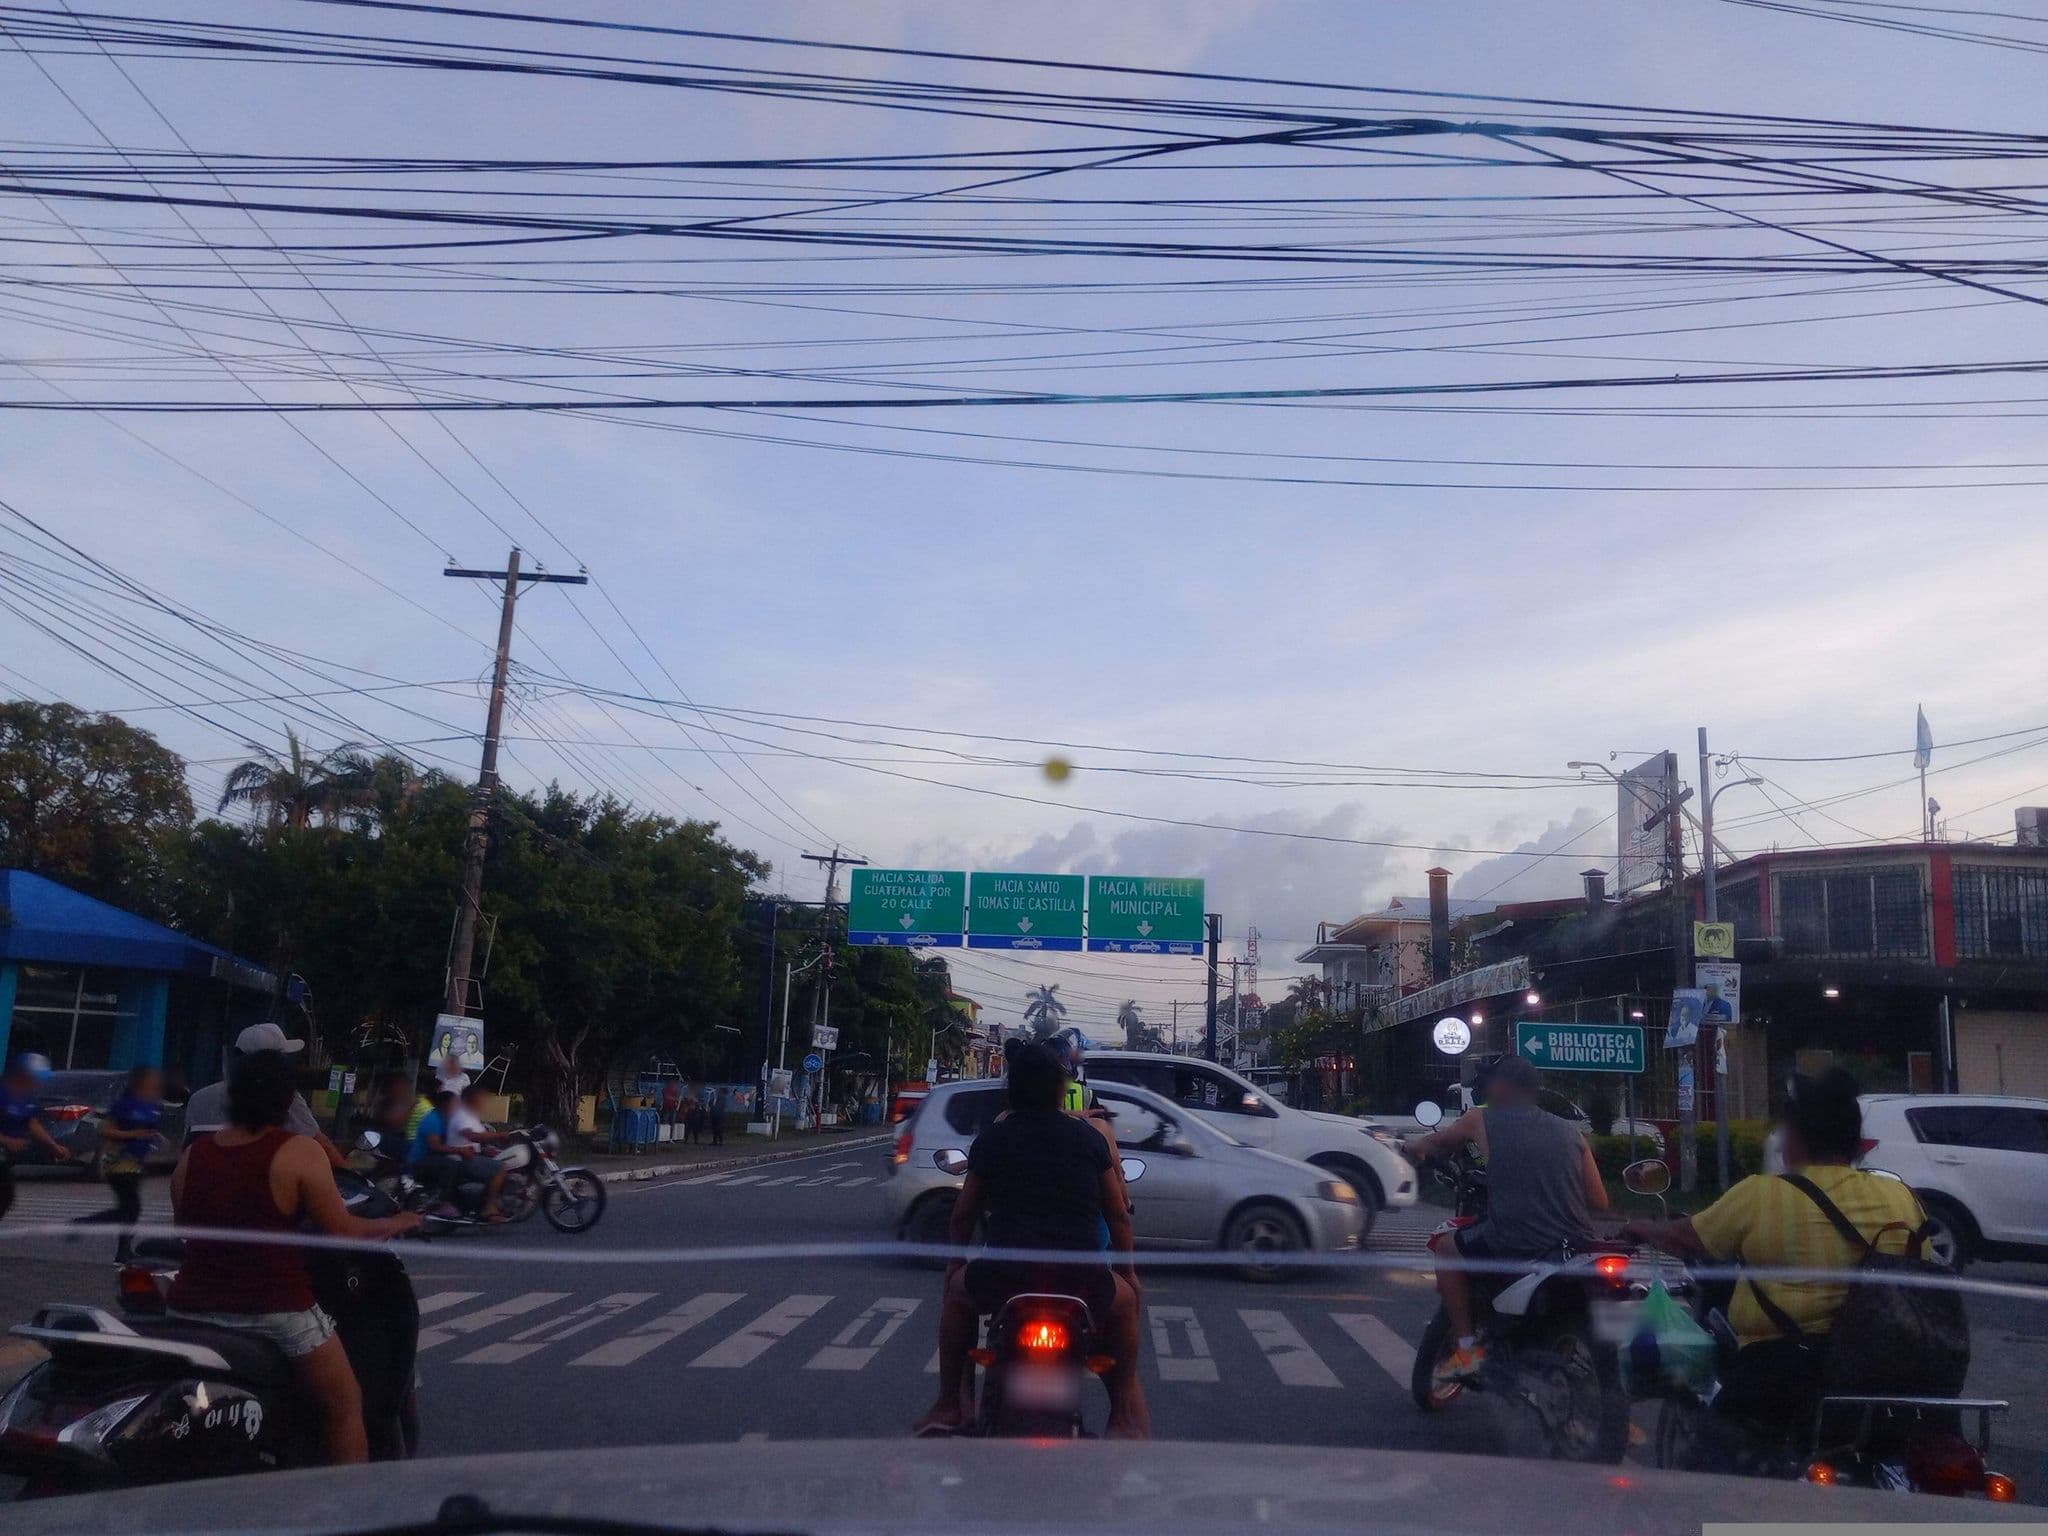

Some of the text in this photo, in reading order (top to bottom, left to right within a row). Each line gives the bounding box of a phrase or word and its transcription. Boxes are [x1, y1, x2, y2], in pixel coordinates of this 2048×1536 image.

[872, 872, 945, 884] HACIA SALIDA
[864, 885, 951, 897] GUATEMALA POR
[994, 879, 1060, 894] HACIA SANTO
[1099, 880, 1193, 898] HACIA MUELLE
[881, 898, 933, 910] 20 CALLE
[977, 896, 1076, 911] TOMAS DE CASTILLA
[1110, 900, 1182, 916] MUNICIPAL
[1548, 1032, 1635, 1049] BIBLIOTECA
[1550, 1047, 1634, 1064] MUNICIPAL
